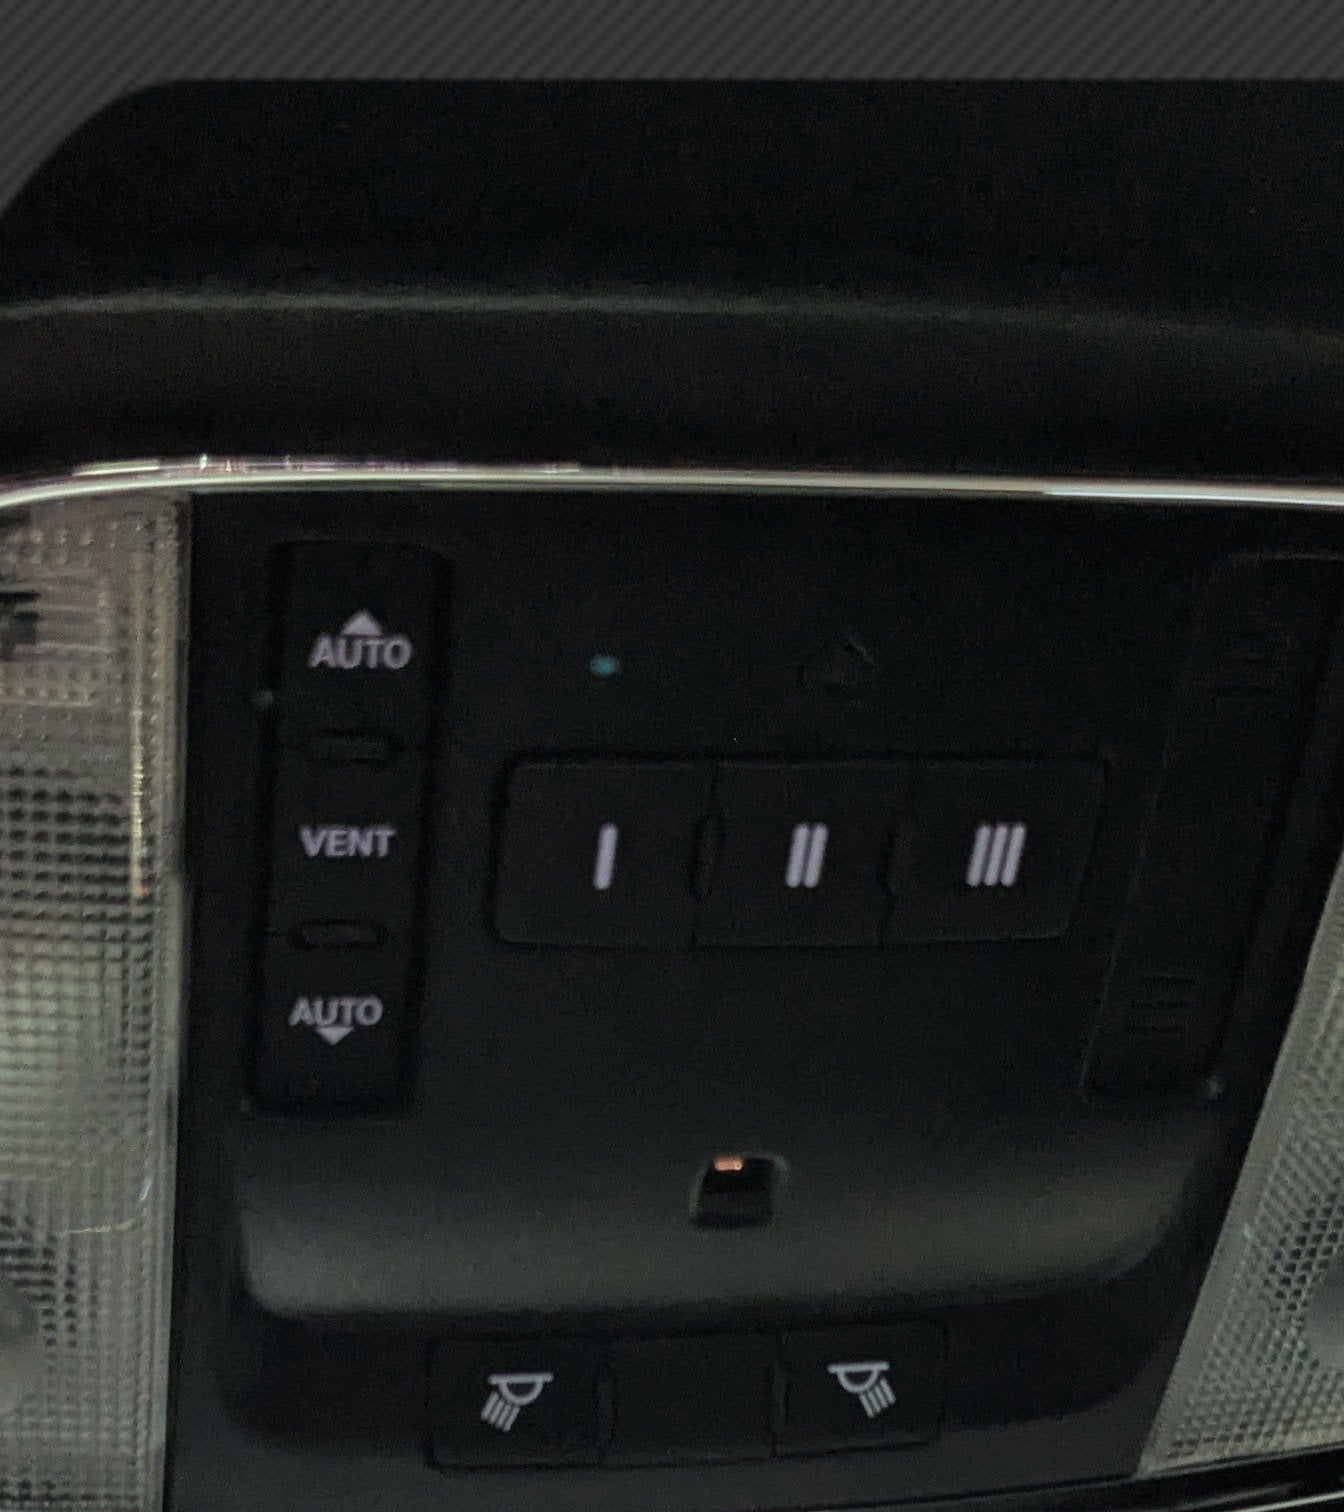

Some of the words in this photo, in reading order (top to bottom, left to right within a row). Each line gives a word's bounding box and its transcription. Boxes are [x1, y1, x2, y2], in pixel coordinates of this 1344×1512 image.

[308, 633, 412, 669] AUTO
[299, 825, 396, 857] VENT
[288, 997, 384, 1027] AUTO
